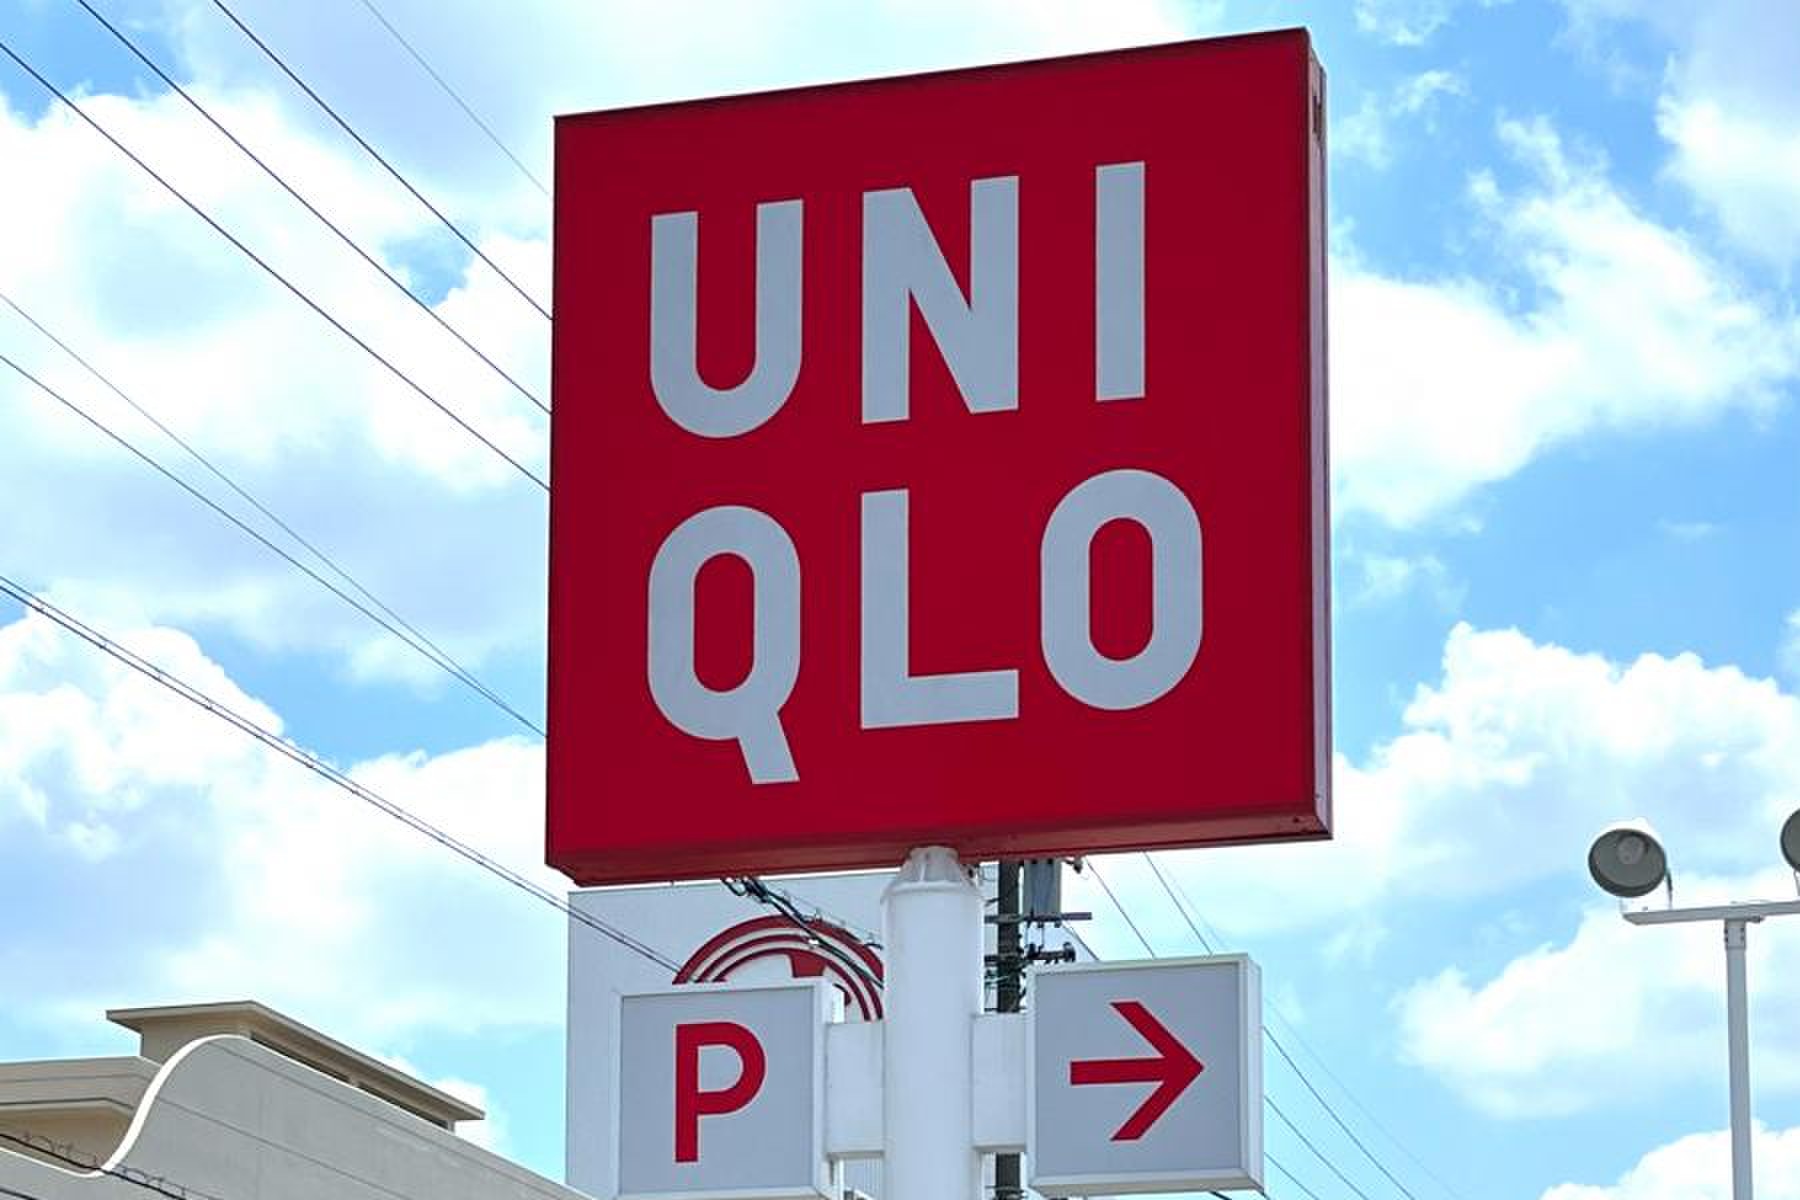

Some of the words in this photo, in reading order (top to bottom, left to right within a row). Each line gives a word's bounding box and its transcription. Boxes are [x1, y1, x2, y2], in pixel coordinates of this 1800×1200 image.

[650, 161, 1146, 439] UNI
[648, 469, 1203, 785] QLO
[674, 1021, 768, 1163] P
